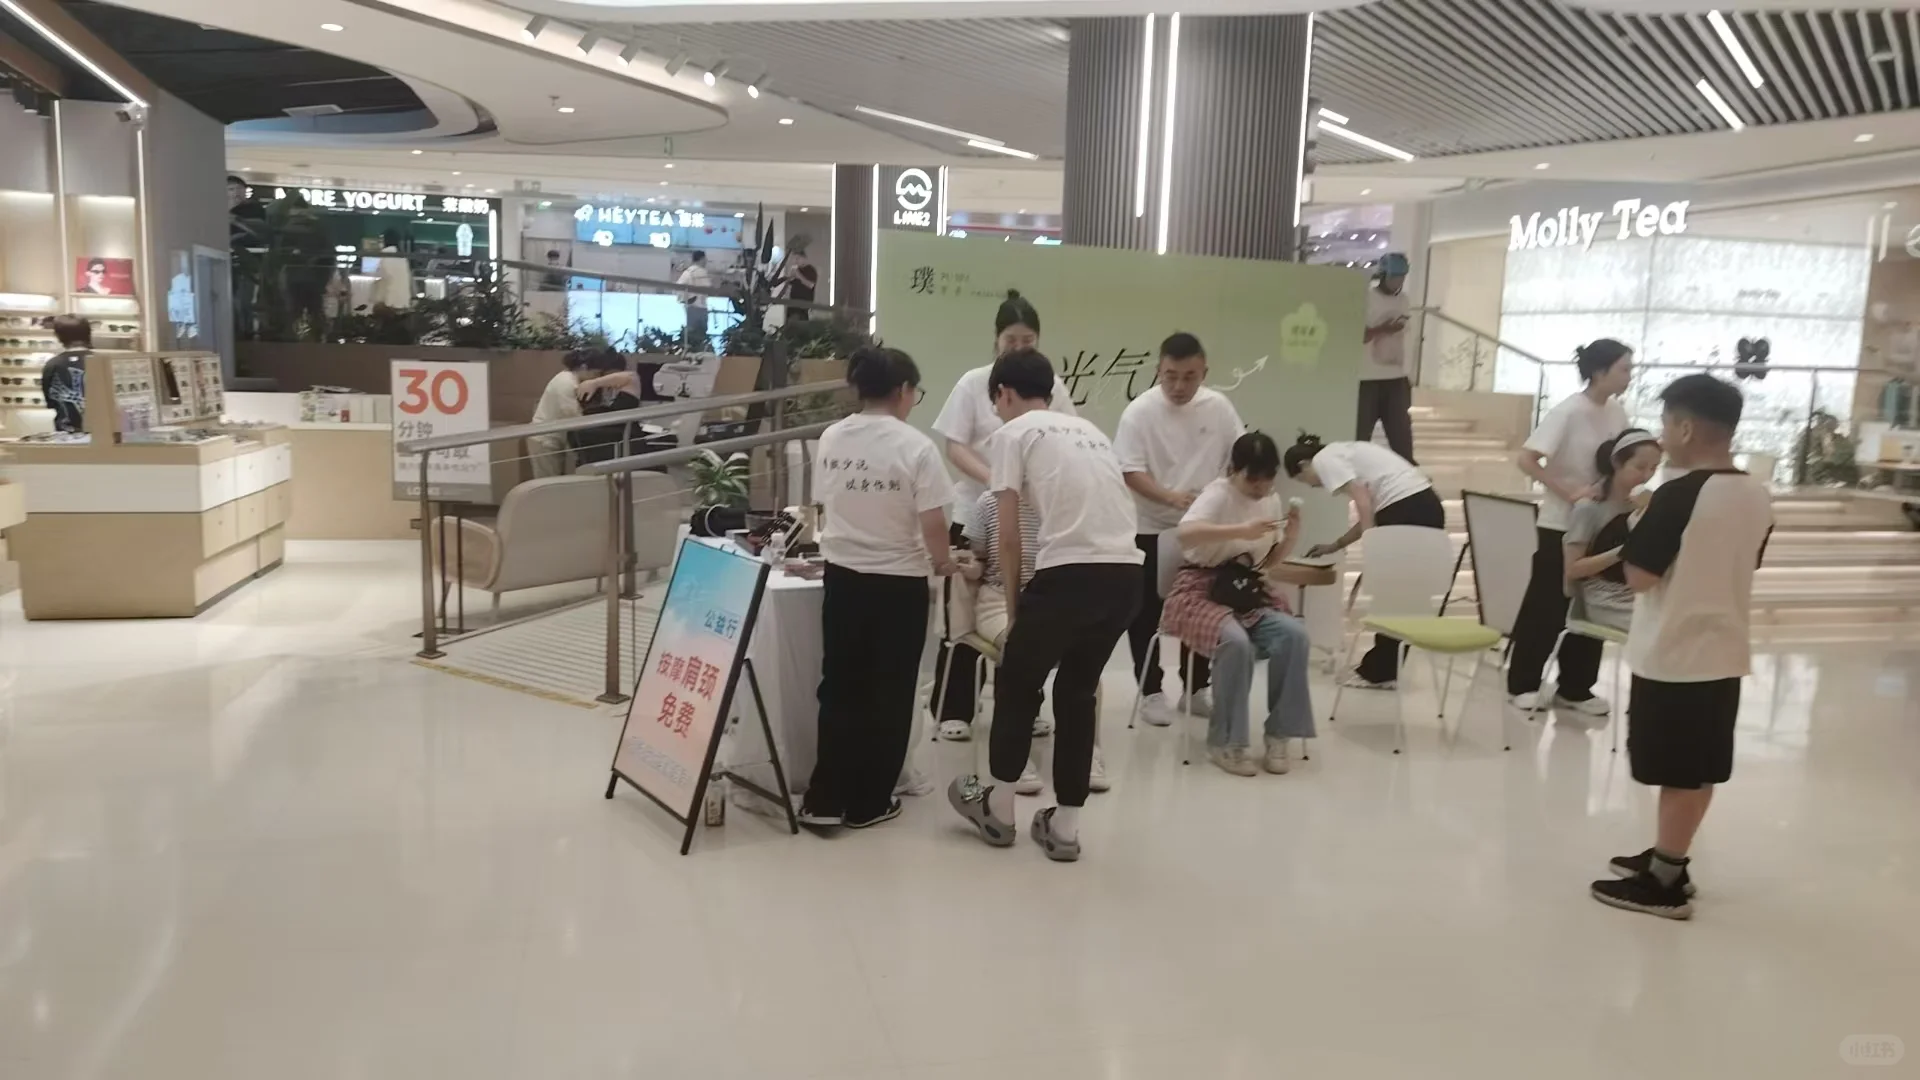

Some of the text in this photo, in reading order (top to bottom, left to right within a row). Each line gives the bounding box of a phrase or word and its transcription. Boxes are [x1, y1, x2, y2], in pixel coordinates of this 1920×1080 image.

[343, 191, 427, 211] YOGURT
[598, 206, 675, 227] HEYTEA
[1508, 198, 1690, 252] Molly Tea
[398, 369, 469, 415] 30
[398, 419, 434, 438] 分钟
[704, 608, 738, 640] 公益行
[656, 651, 720, 701] 按摩肩颈
[657, 691, 695, 738] 免费
